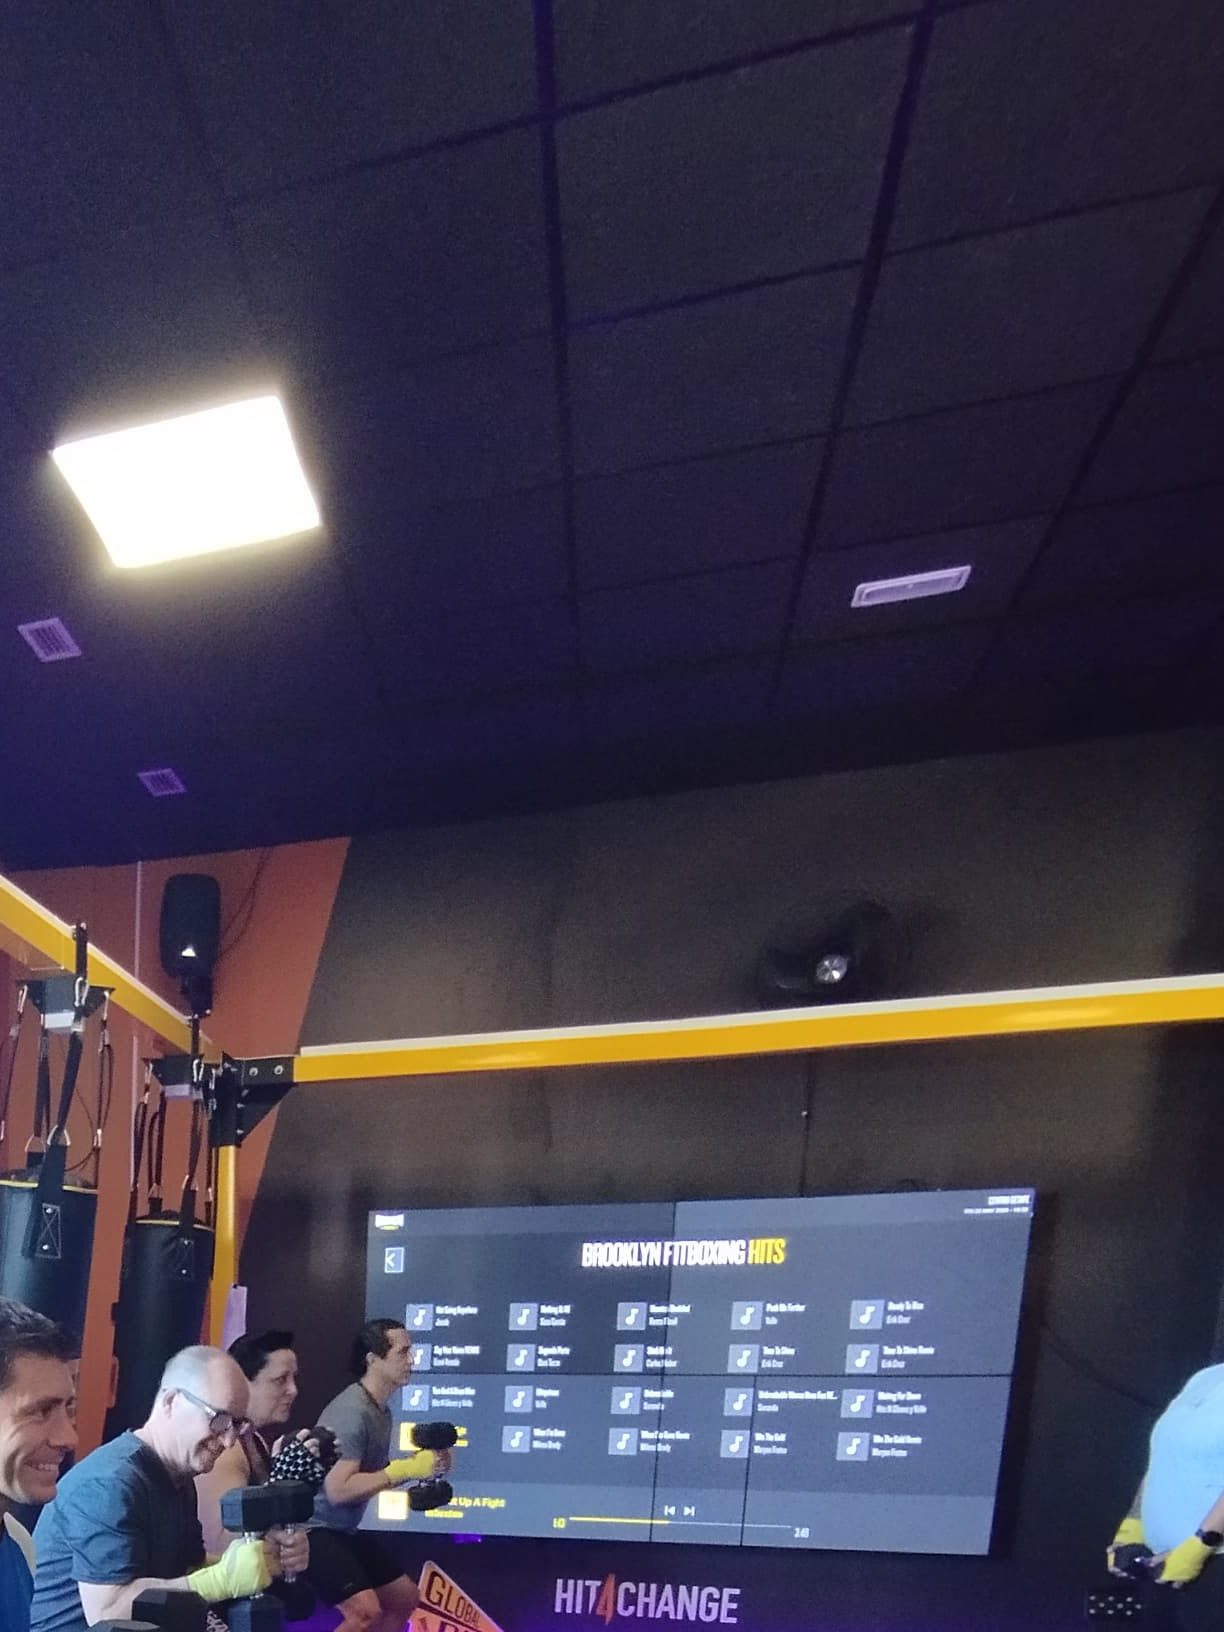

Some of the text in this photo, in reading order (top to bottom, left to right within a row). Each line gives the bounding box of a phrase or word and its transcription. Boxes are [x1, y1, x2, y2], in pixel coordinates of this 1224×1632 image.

[581, 1237, 787, 1268] BROOKLYN FITBOXING HITS
[459, 1497, 473, 1508] Up
[473, 1498, 481, 1507] A
